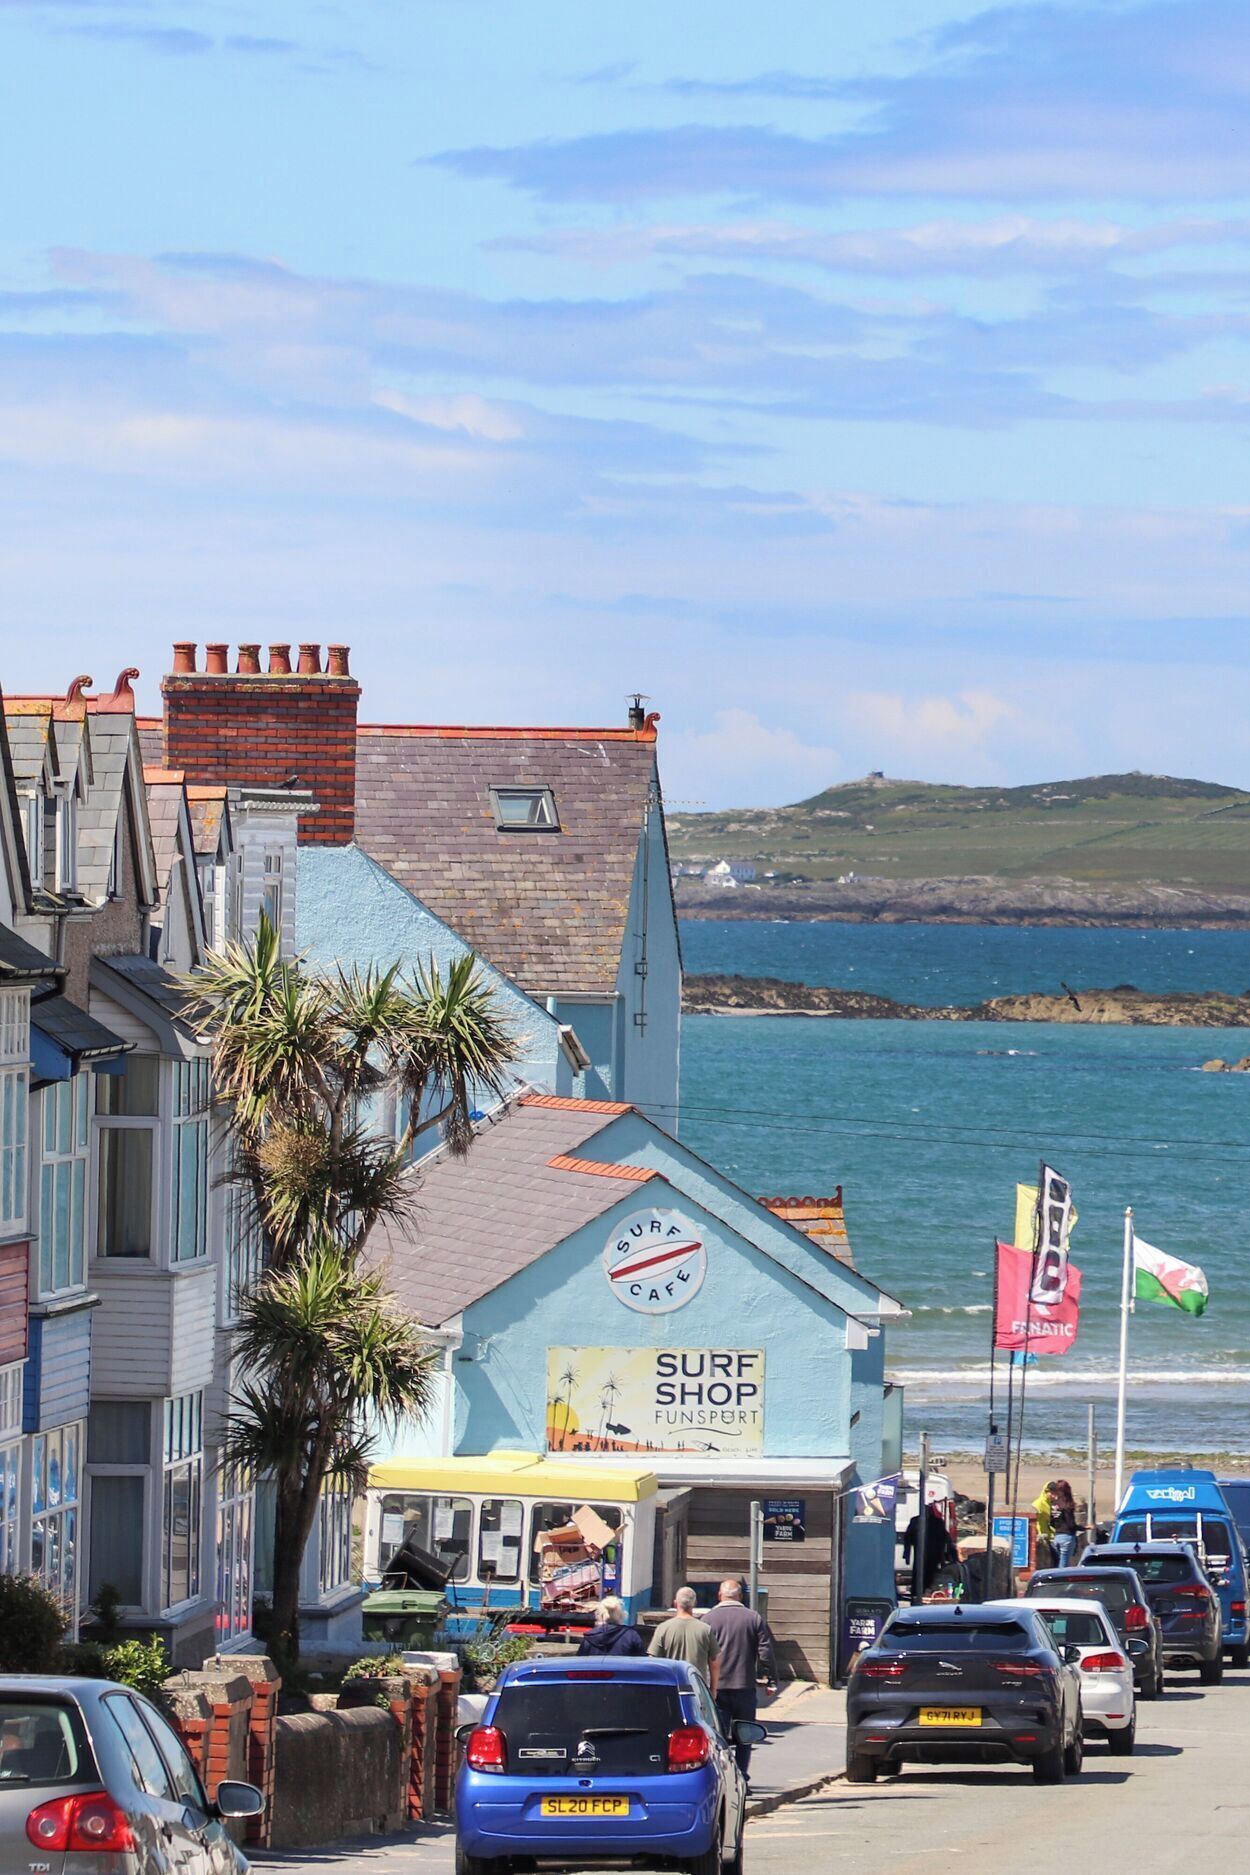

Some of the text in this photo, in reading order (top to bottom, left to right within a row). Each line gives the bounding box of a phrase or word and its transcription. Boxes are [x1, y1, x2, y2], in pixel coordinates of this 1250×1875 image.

[616, 1220, 681, 1254] SURF
[629, 1269, 691, 1301] CAFE
[1011, 1320, 1074, 1338] FANATIC
[656, 1353, 759, 1378] SURF
[655, 1382, 758, 1406] SHOP
[655, 1410, 759, 1425] FUNSPORT
[849, 1626, 876, 1636] FARM
[547, 1799, 622, 1813] SL20 FCP
[28, 1863, 51, 1872] TDI
